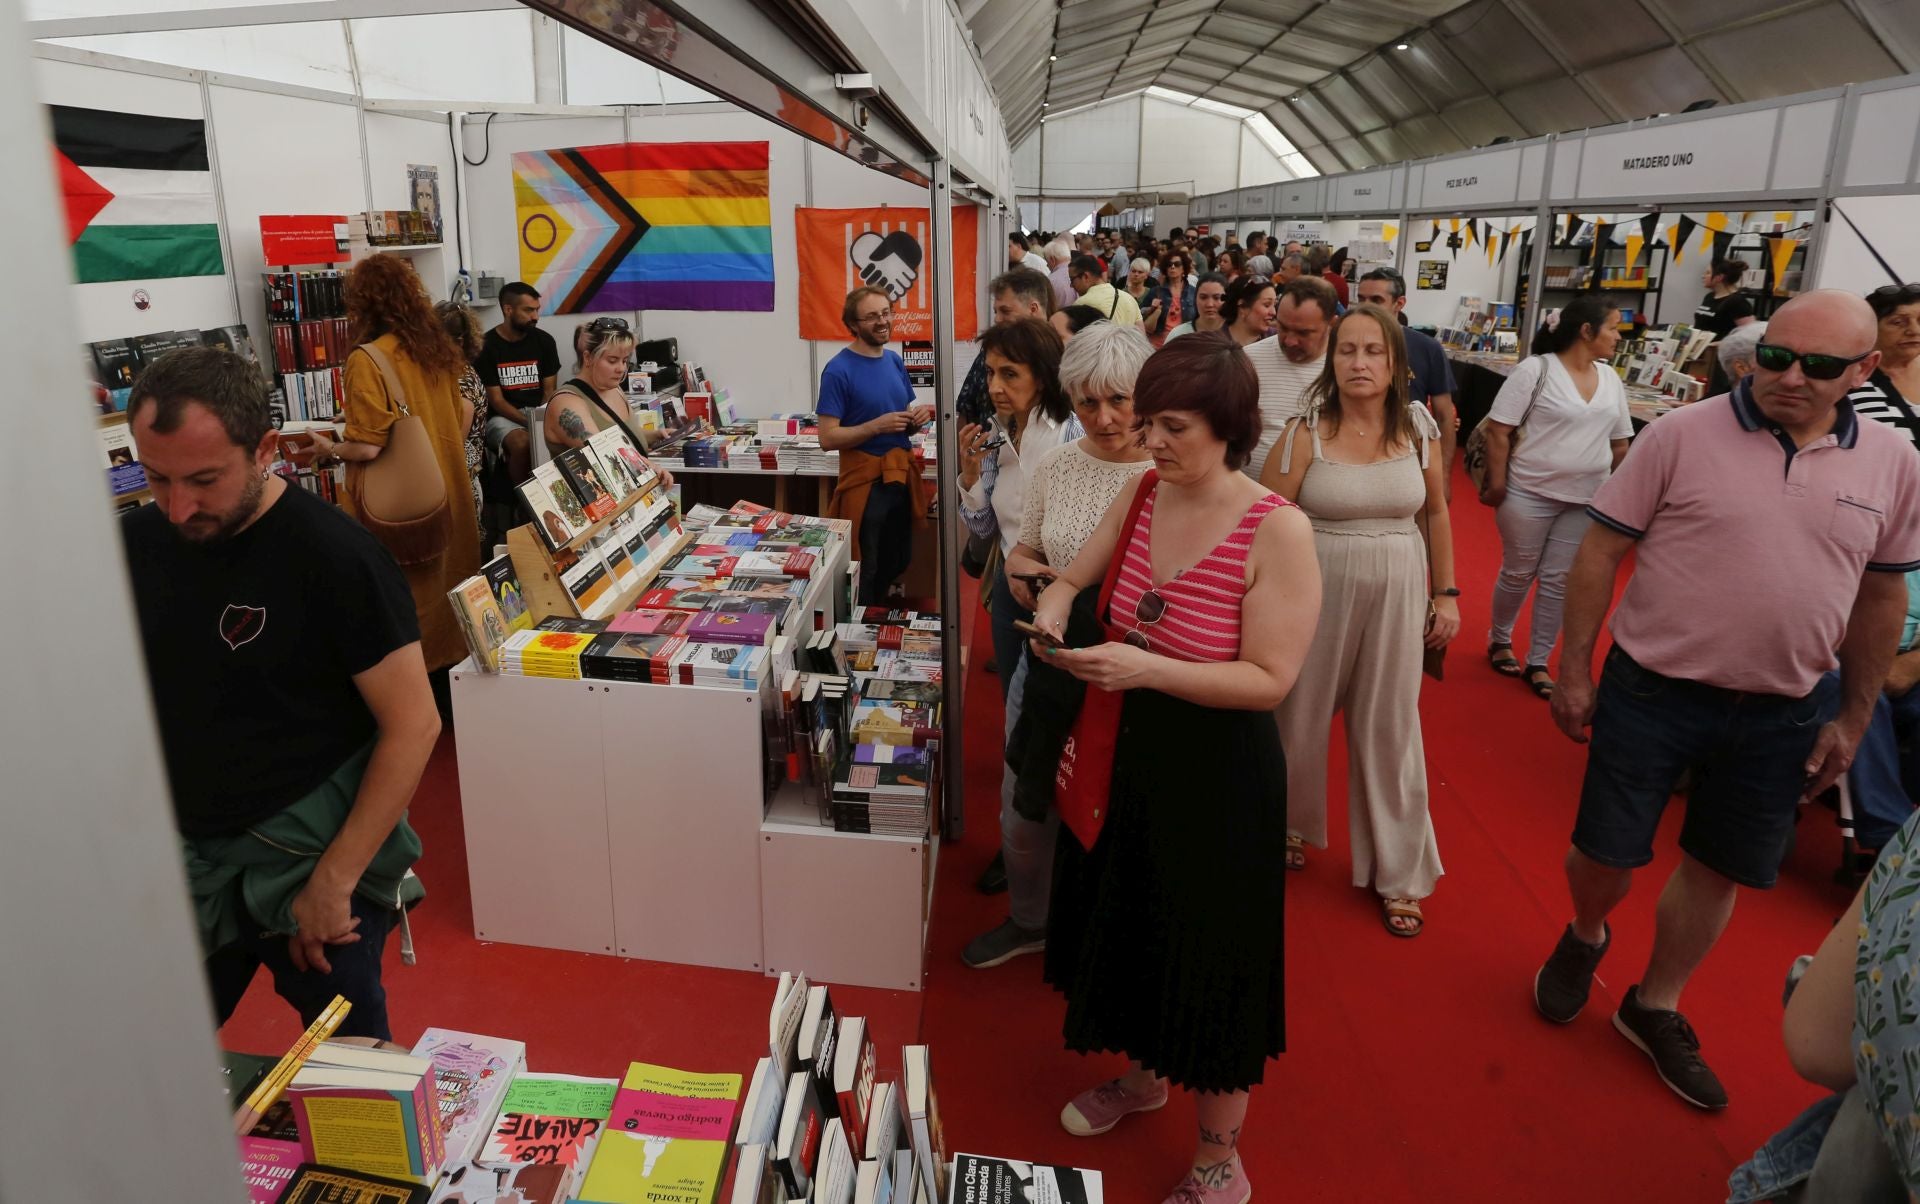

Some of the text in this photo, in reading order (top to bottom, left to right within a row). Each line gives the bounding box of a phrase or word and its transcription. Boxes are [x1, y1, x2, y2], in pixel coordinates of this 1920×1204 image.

[1622, 152, 1694, 171] MATADERO UNO
[1446, 179, 1455, 188] PEZ
[1463, 176, 1478, 186] PLATA
[633, 1108, 722, 1125] Rodrigo Cuevas
[497, 1112, 600, 1146] CÁLLATE
[266, 1166, 296, 1180] Hill
[965, 1159, 977, 1185] Clara
[995, 1164, 1004, 1193] queman
[979, 1165, 990, 1204] maseda
[1004, 1175, 1012, 1204] ombres
[646, 1192, 682, 1203] xorda
